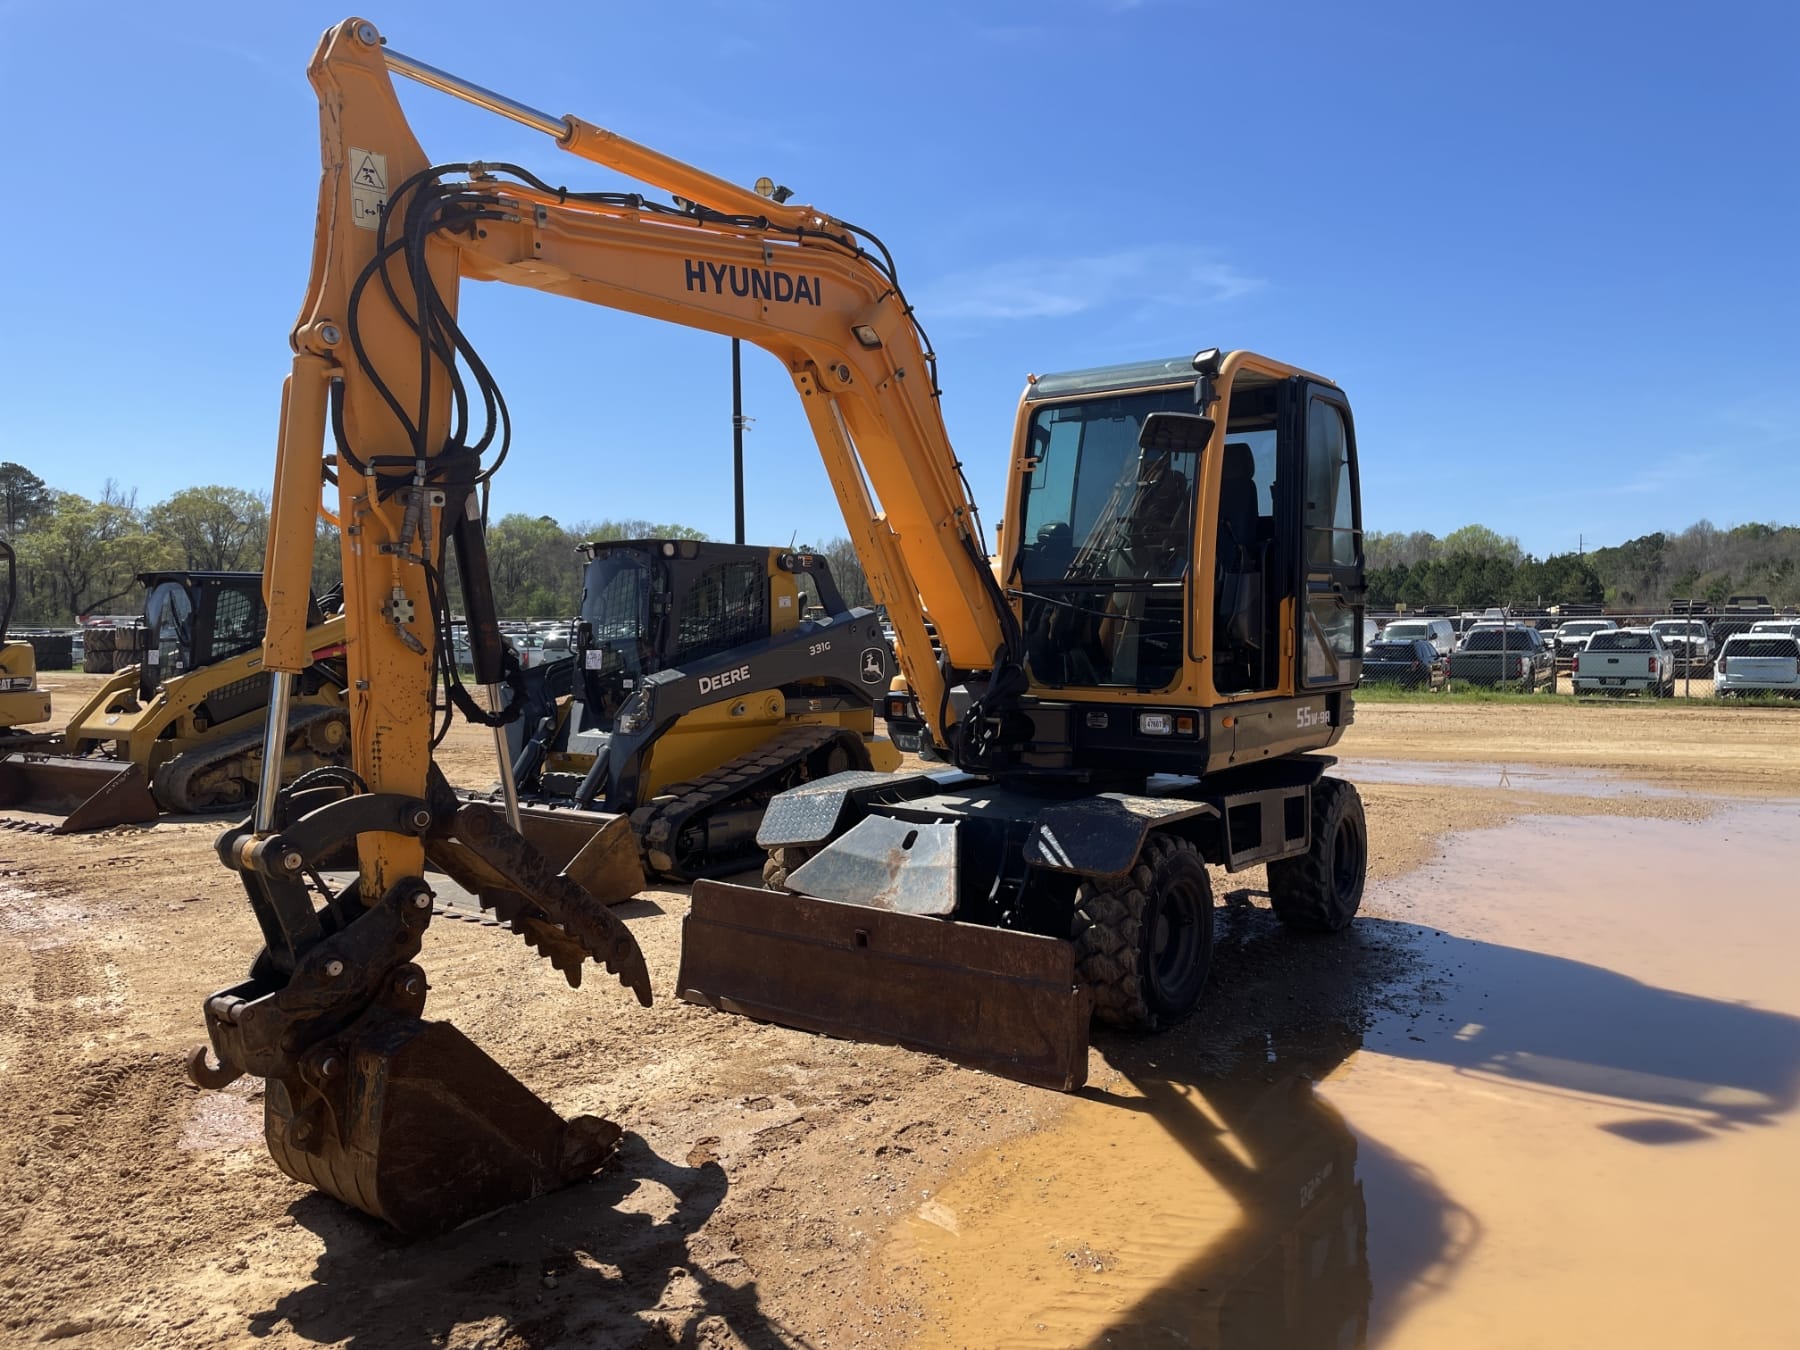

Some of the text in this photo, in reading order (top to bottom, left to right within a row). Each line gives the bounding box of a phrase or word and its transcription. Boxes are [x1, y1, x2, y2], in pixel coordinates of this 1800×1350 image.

[685, 259, 821, 306] HYUNDAI
[809, 641, 831, 656] 331G
[0, 679, 12, 690] AT
[698, 665, 750, 695] DEERE
